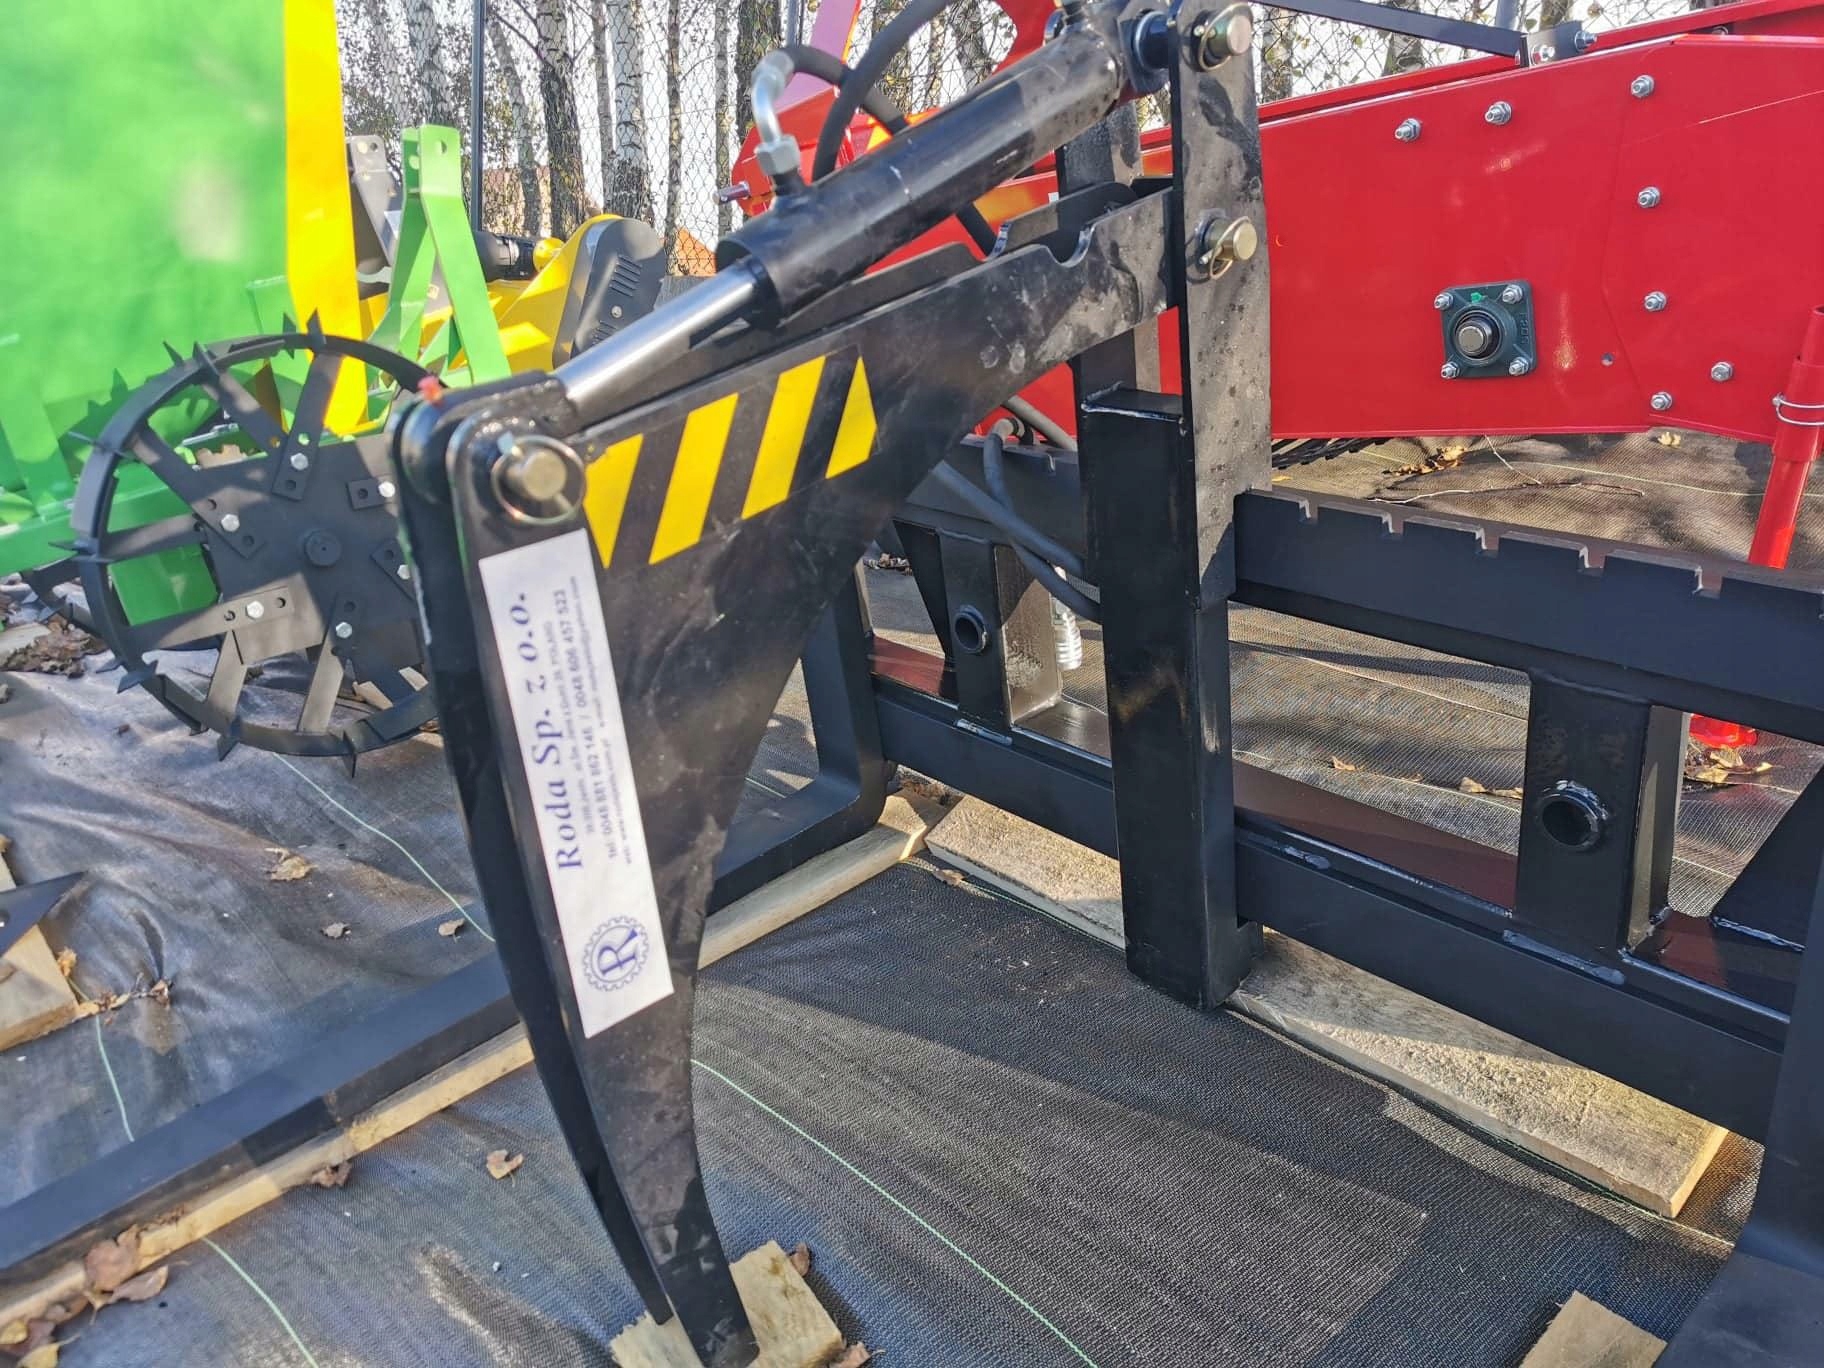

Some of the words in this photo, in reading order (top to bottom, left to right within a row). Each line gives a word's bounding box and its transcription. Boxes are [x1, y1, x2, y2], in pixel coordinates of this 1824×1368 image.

[510, 594, 538, 662] o.o.
[525, 674, 546, 694] z
[532, 708, 563, 765] Sp.
[545, 780, 582, 869] Roda
[597, 928, 639, 976] R
